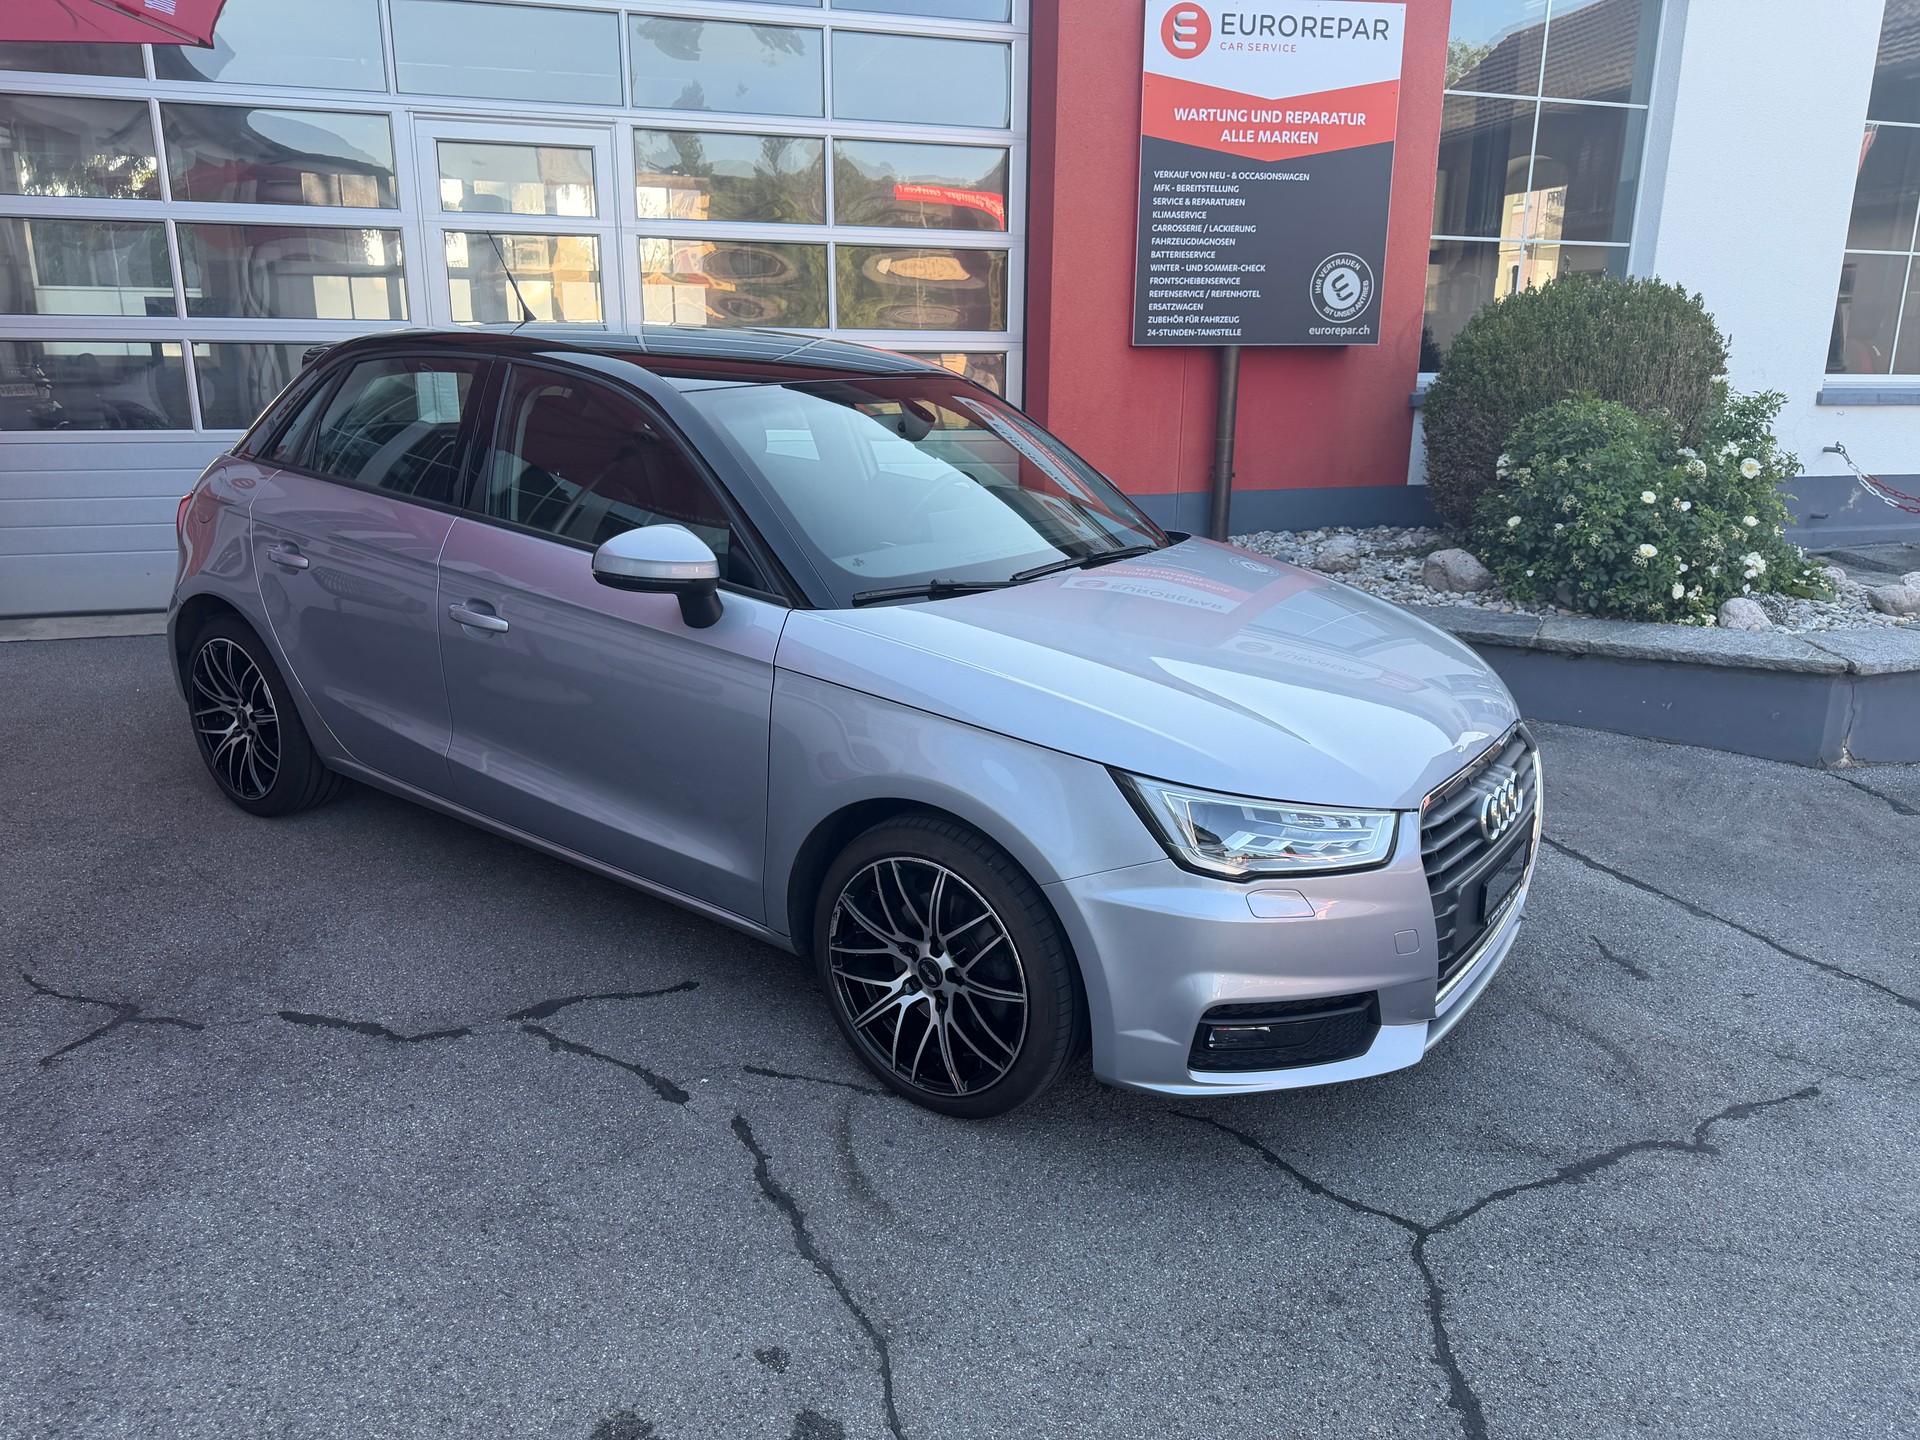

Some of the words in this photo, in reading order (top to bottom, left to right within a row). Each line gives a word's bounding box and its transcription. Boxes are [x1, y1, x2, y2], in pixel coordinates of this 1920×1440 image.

[1220, 13, 1389, 41] EUROREPAR
[1220, 42, 1243, 51] CAR
[1247, 43, 1297, 52] SERVICE
[1174, 108, 1248, 123] WARTUNG
[1251, 110, 1282, 123] UND
[1285, 111, 1366, 125] REPARATUR
[1220, 129, 1254, 142] ALLE
[1257, 131, 1319, 144] MARKEN
[1154, 170, 1190, 179] VERKAUF
[1190, 171, 1209, 179] VON
[1209, 171, 1226, 180] NEU
[1231, 172, 1238, 180] &
[1238, 172, 1310, 181] OCCASIONSWAGEN
[1153, 184, 1170, 192] MFK
[1176, 184, 1240, 193] BEREITSTELLUNG
[1152, 197, 1183, 206] SERVICE
[1184, 198, 1191, 206] &
[1191, 198, 1246, 206] REPARATUREN
[1152, 211, 1207, 219] KLIMASERVICE
[1151, 224, 1202, 232] CARROSSERIE
[1209, 224, 1257, 233] LACKIERUNG
[1151, 237, 1236, 246] FAHRZEUGDIAGNOSEN
[1150, 250, 1216, 259] BATTERIESERVICE
[1150, 264, 1180, 272] WINTER
[1186, 264, 1203, 272] UND
[1204, 264, 1266, 272] SOMMER-CHECK
[1318, 258, 1361, 278] VERTRAUEN
[1149, 277, 1241, 285] FRONTSCHEIBENSERVICE
[1315, 279, 1323, 294] IHR
[1149, 290, 1204, 298] REIFENSERVICE
[1211, 290, 1261, 298] REIFENHOTEL
[1323, 306, 1334, 316] IST
[1333, 307, 1356, 318] UNSER
[1355, 279, 1369, 311] ANTRIEB
[1148, 303, 1203, 311] ERSATZWAGEN
[1147, 314, 1184, 323] ZUBEHÖR
[1185, 314, 1199, 323] FÜR
[1147, 328, 1242, 337] 24-STUNDEN-TANKSTELLE
[1309, 325, 1370, 337] eurorepar.ch
